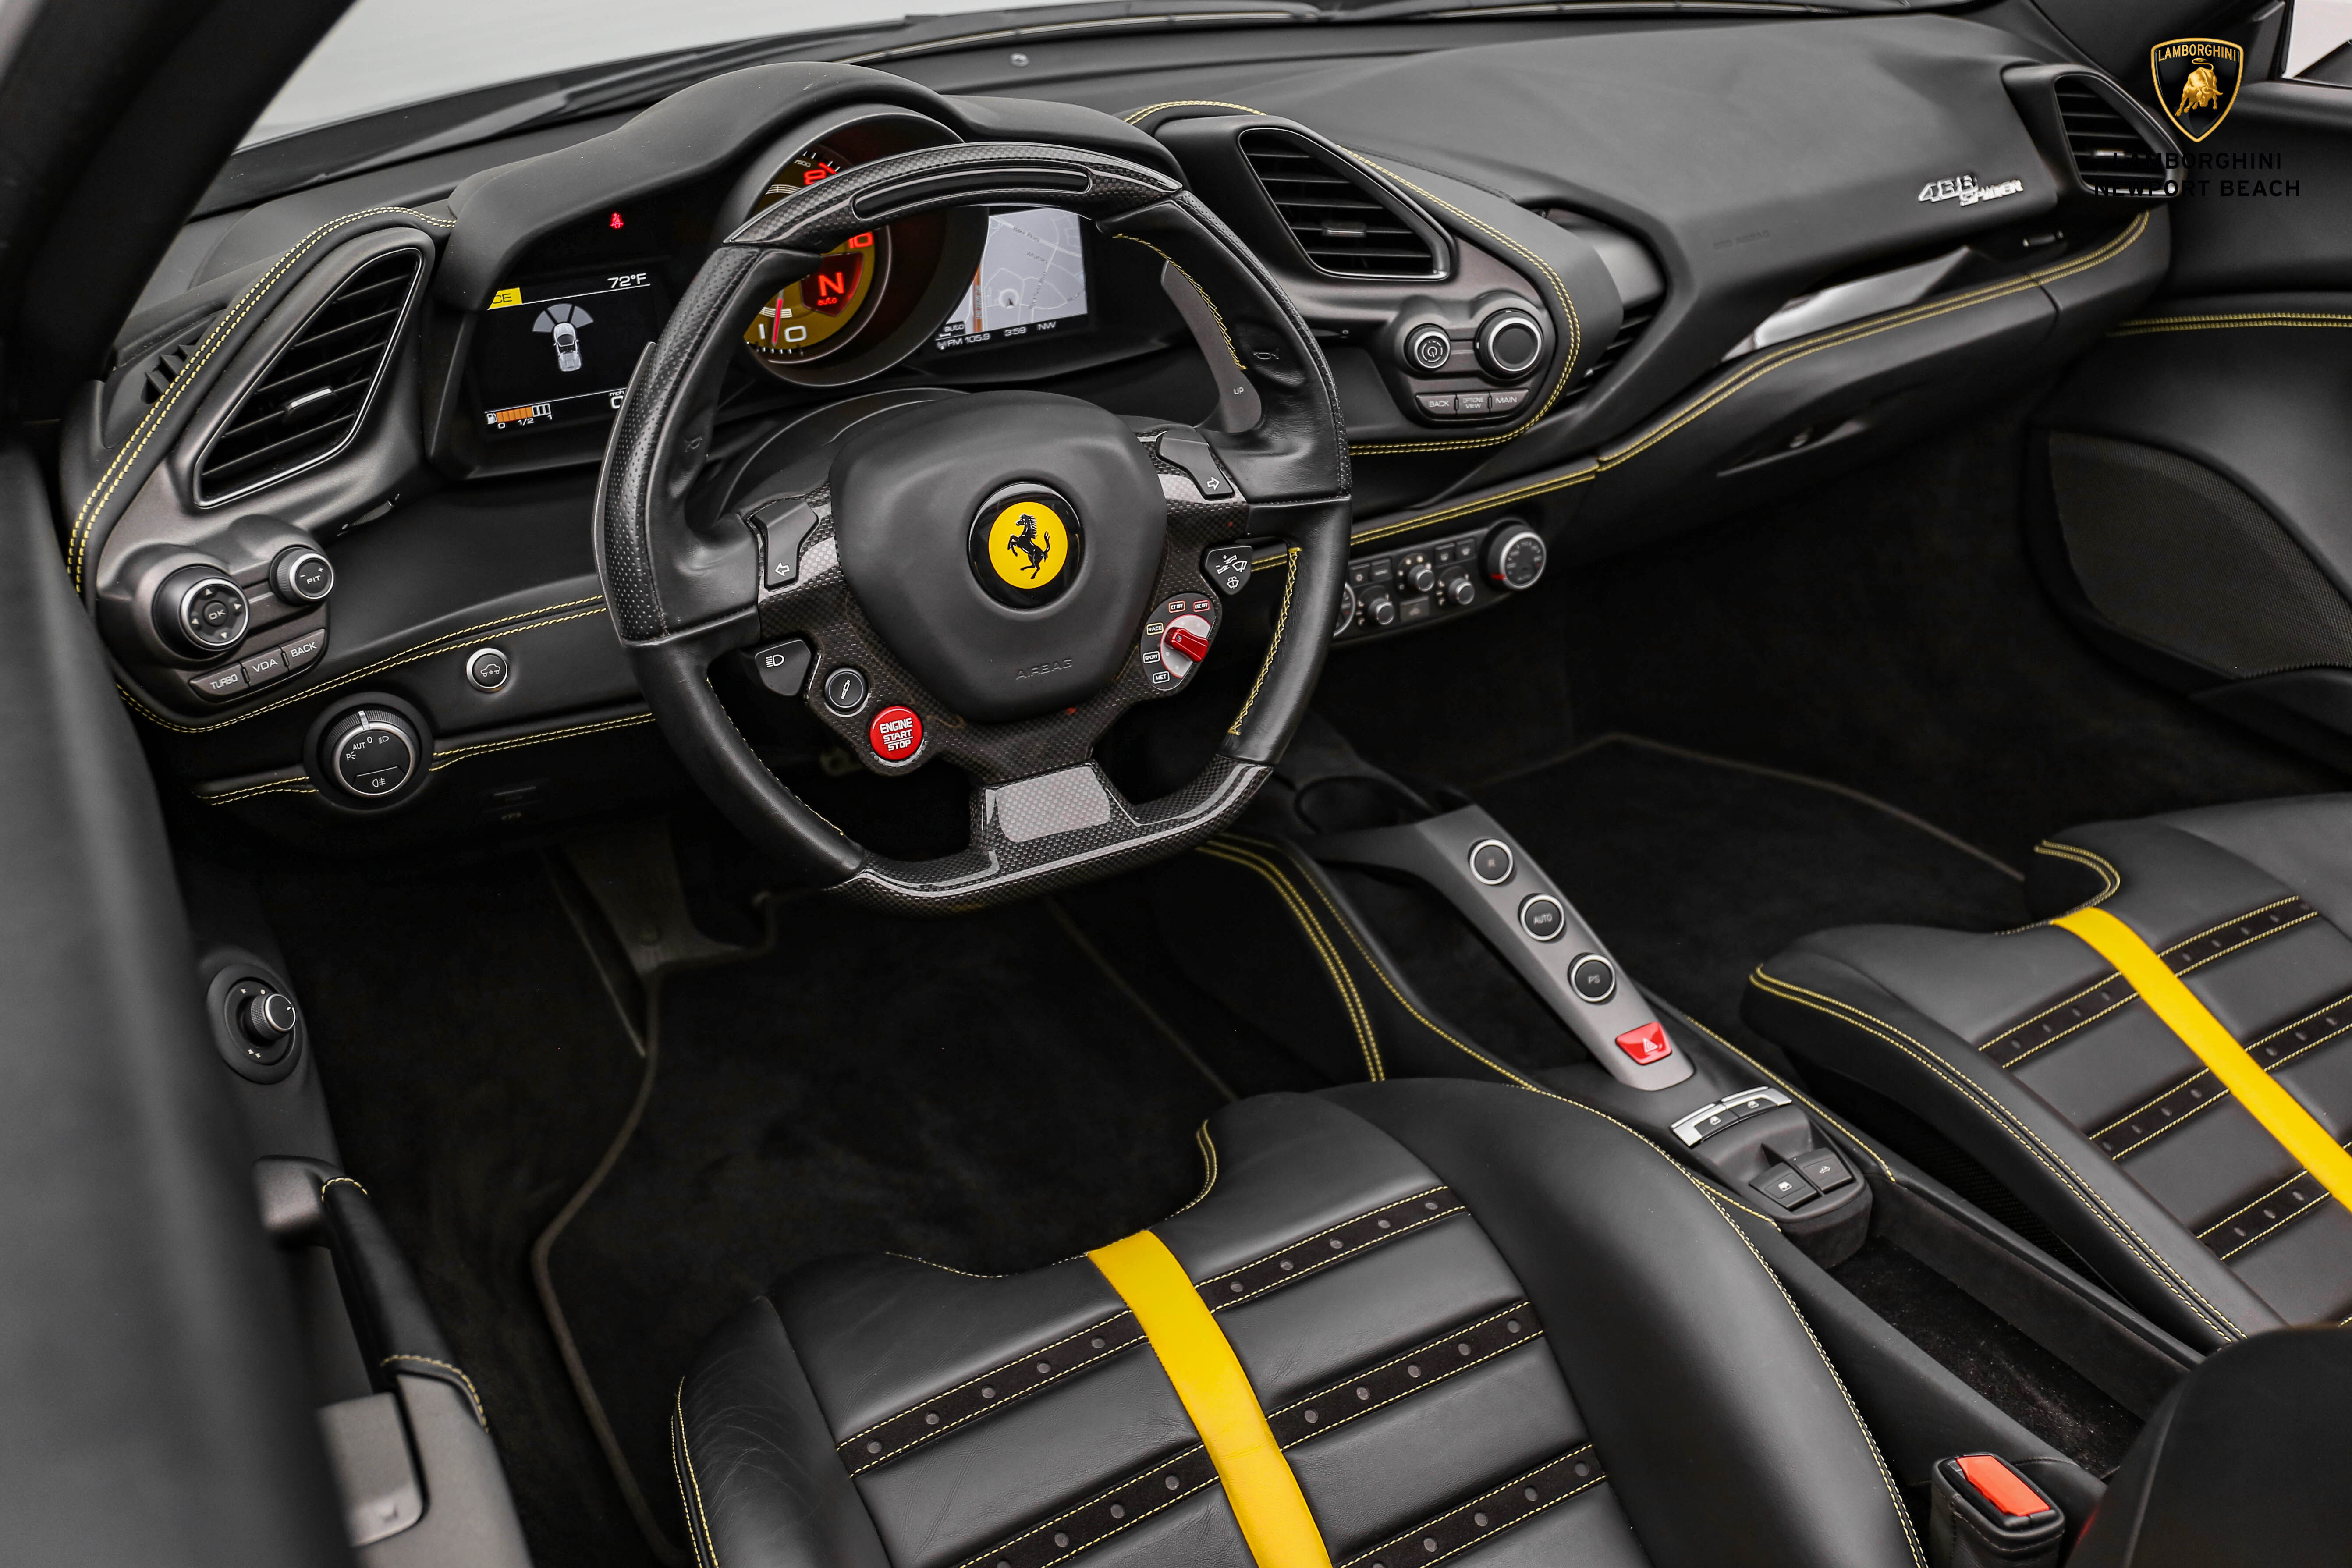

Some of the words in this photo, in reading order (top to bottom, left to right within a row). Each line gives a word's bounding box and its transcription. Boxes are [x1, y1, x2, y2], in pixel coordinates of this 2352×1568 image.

[848, 232, 874, 249] 10
[607, 273, 646, 288] 72°F
[819, 272, 844, 297] N
[947, 338, 963, 347] FM
[965, 333, 990, 343] 105.9
[1004, 327, 1026, 337] 3:59
[1037, 321, 1057, 330] NW
[517, 418, 534, 426] 1/2
[307, 575, 321, 585] PIT
[208, 609, 226, 620] OK
[290, 642, 317, 658] BACK
[252, 658, 278, 673] VDA
[210, 674, 238, 690] TURBO
[879, 717, 913, 734] ENGINE
[883, 729, 912, 742] START
[888, 739, 912, 752] STOP
[1533, 914, 1552, 925] AUTO
[1588, 975, 1600, 984] PS
